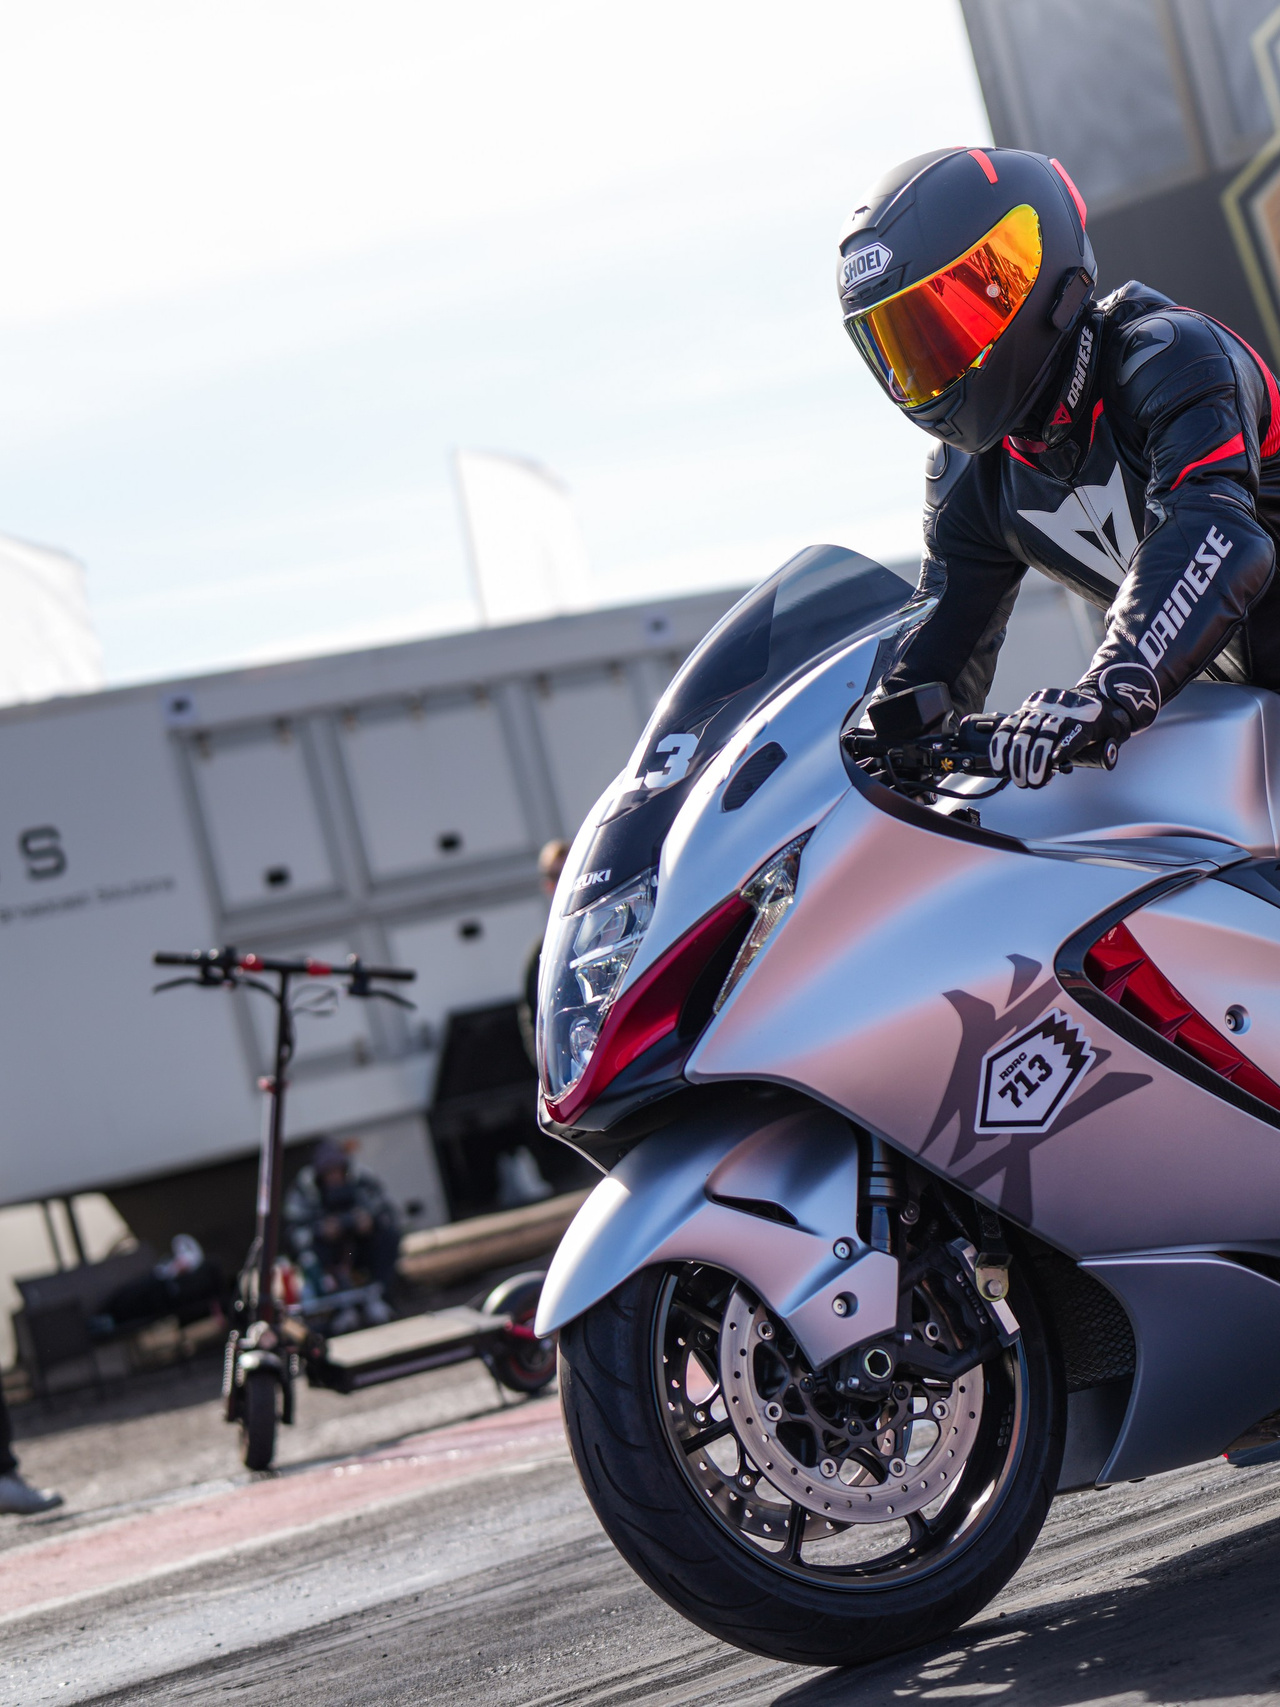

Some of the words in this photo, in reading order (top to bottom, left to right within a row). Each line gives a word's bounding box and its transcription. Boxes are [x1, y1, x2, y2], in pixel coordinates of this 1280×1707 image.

[843, 249, 882, 285] SHOEI
[1137, 524, 1234, 670] DAINESE
[997, 1053, 1053, 1109] 713
[998, 1051, 1028, 1081] RDRC
